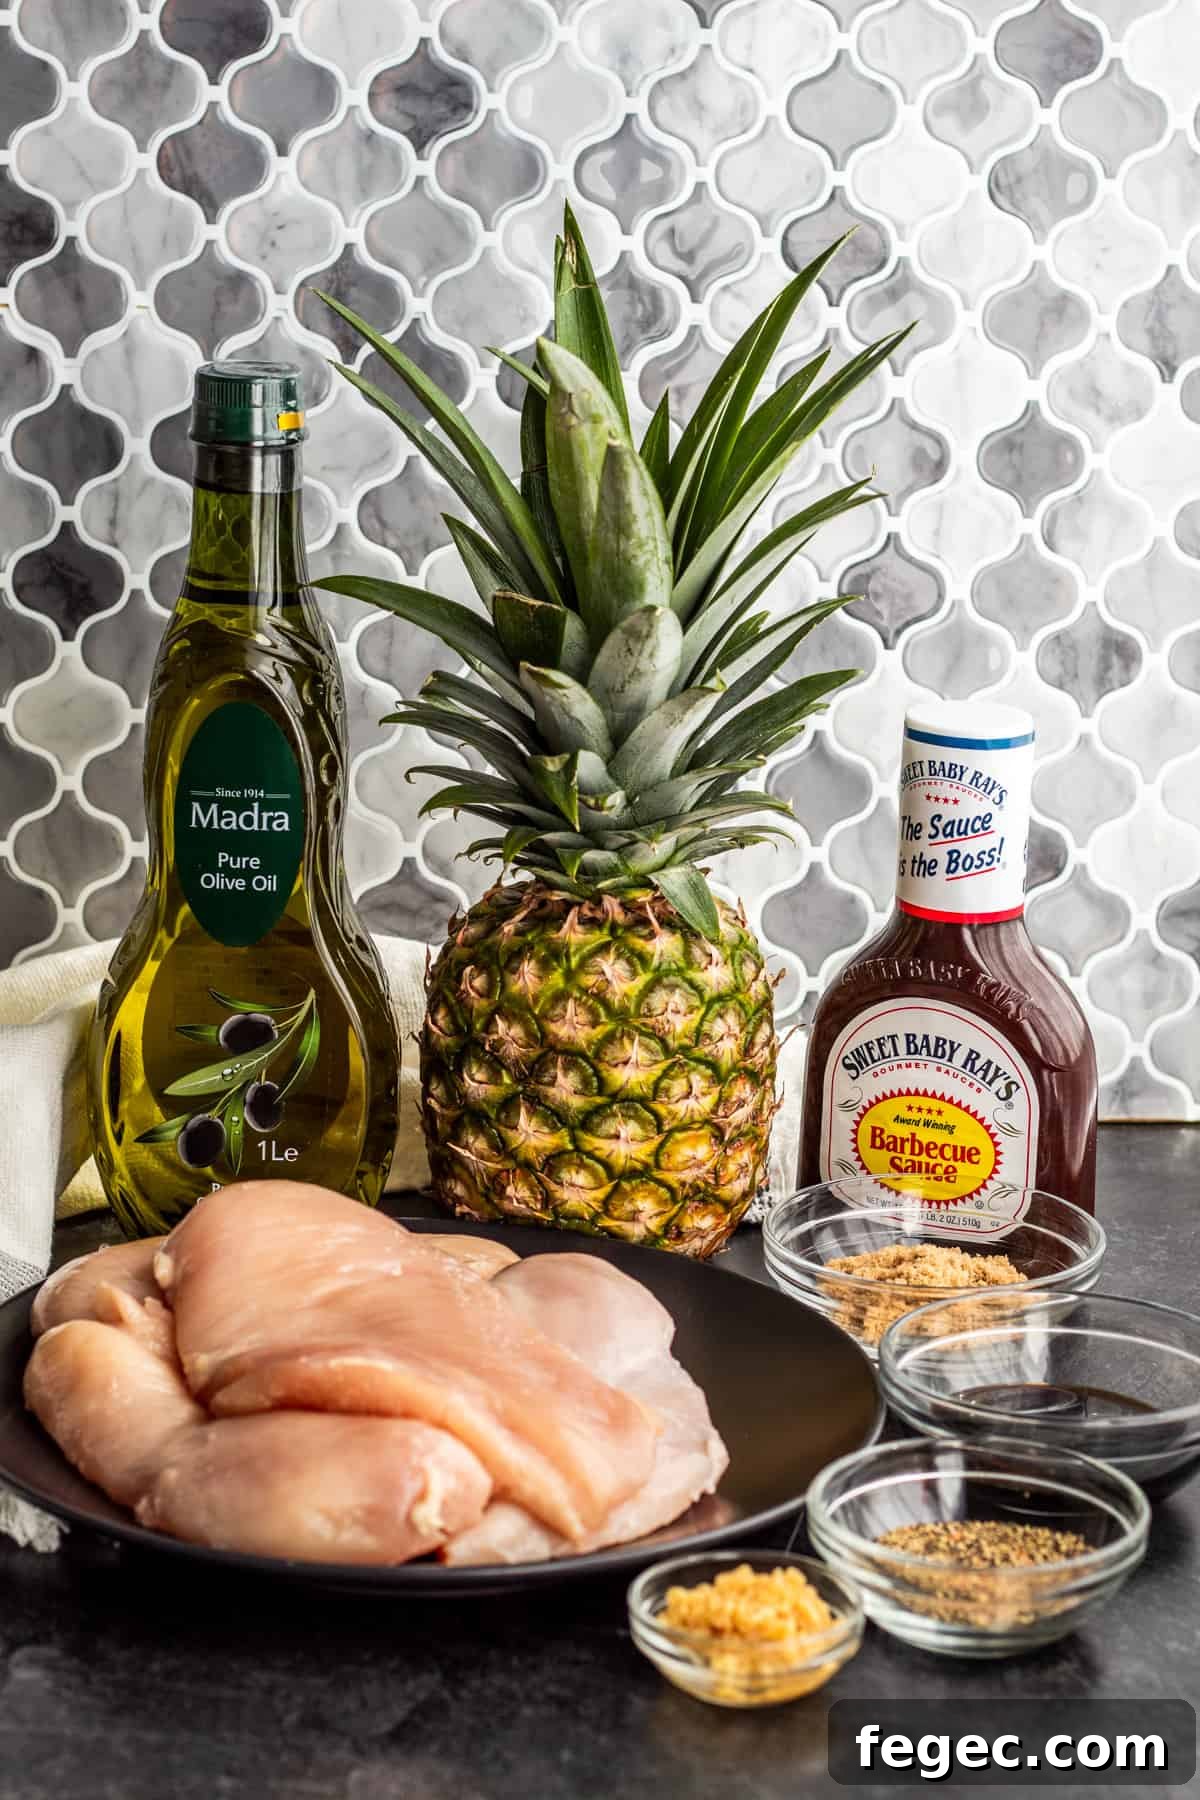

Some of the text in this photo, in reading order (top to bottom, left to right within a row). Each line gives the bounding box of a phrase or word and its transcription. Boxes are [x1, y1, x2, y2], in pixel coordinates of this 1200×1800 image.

[215, 787, 264, 799] Since 1914
[927, 760, 968, 781] BABY
[968, 770, 1008, 806] RAY'S
[189, 801, 291, 832] Madra
[901, 812, 993, 842] The Sauce
[218, 852, 261, 869] Pure
[911, 851, 938, 878] the
[945, 836, 1005, 875] Boss!
[200, 873, 277, 892] Olive Oil
[841, 1033, 1020, 1102] SWEET BABY RAY'S
[872, 1062, 983, 1094] GOURMET SAUCES
[893, 1114, 957, 1136] Award Winning
[870, 1125, 982, 1166] Barbecue
[889, 1155, 958, 1184] Sauce
[939, 1214, 945, 1223] 2
